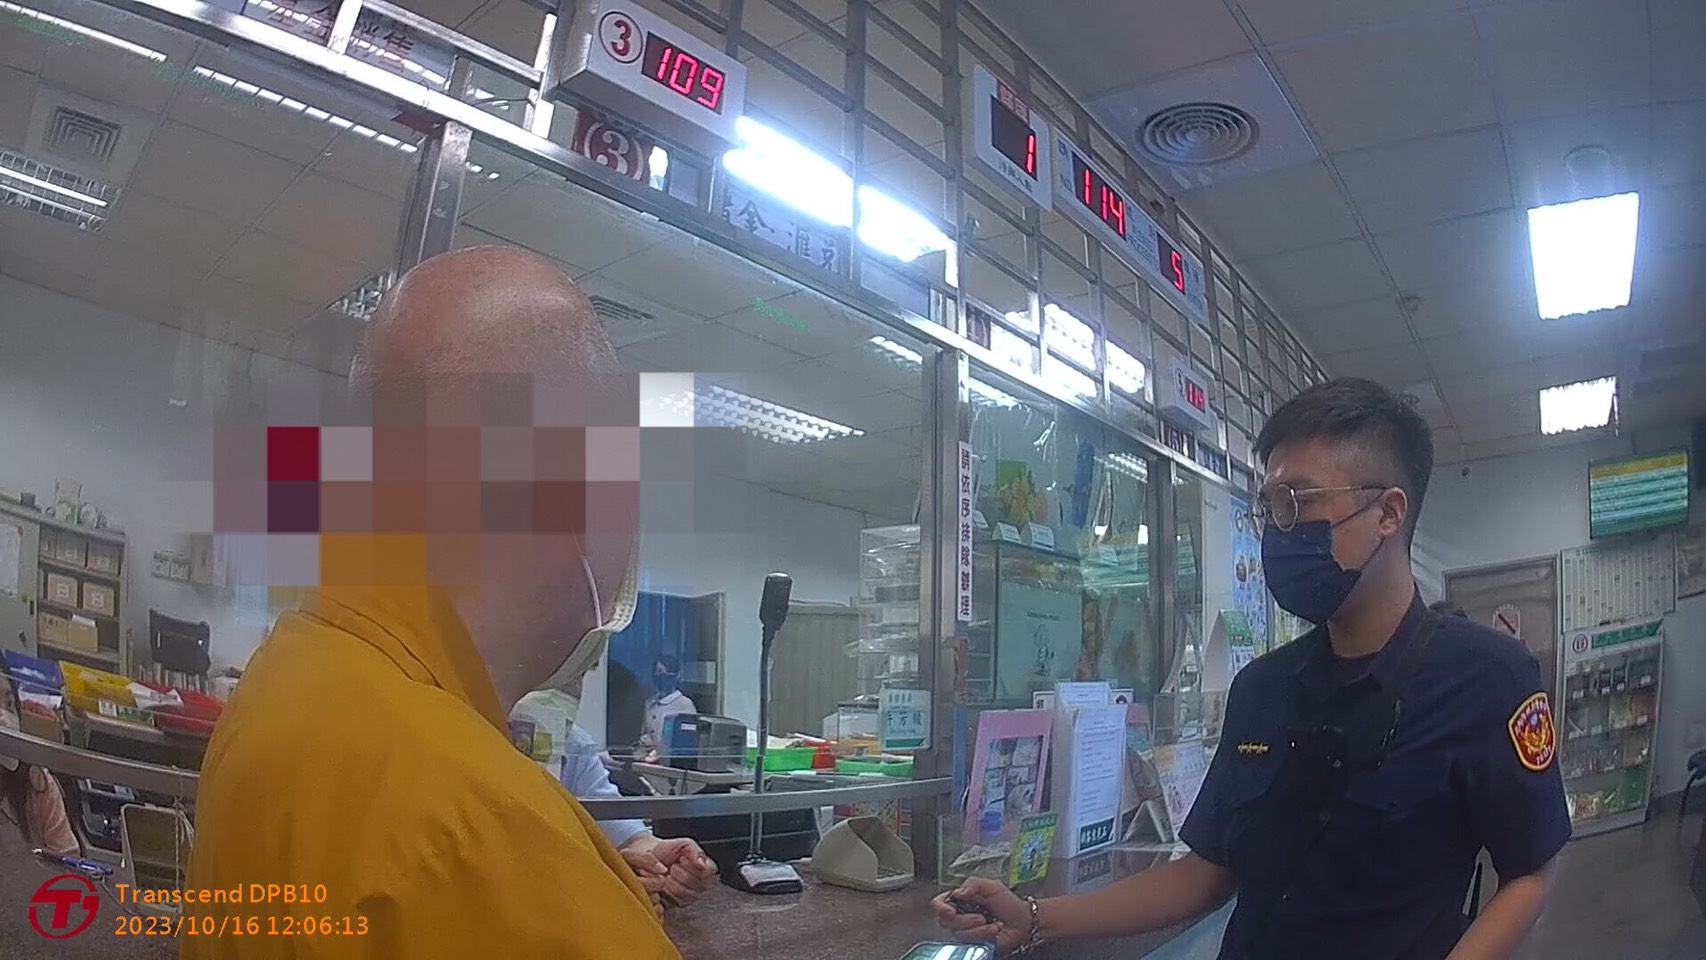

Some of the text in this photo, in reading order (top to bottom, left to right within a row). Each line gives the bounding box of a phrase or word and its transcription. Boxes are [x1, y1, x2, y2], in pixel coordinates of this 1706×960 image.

[656, 47, 725, 110] 109
[602, 130, 630, 175] 3
[1026, 134, 1036, 174] 1
[1083, 168, 1125, 236] 114
[1171, 249, 1185, 292] 5
